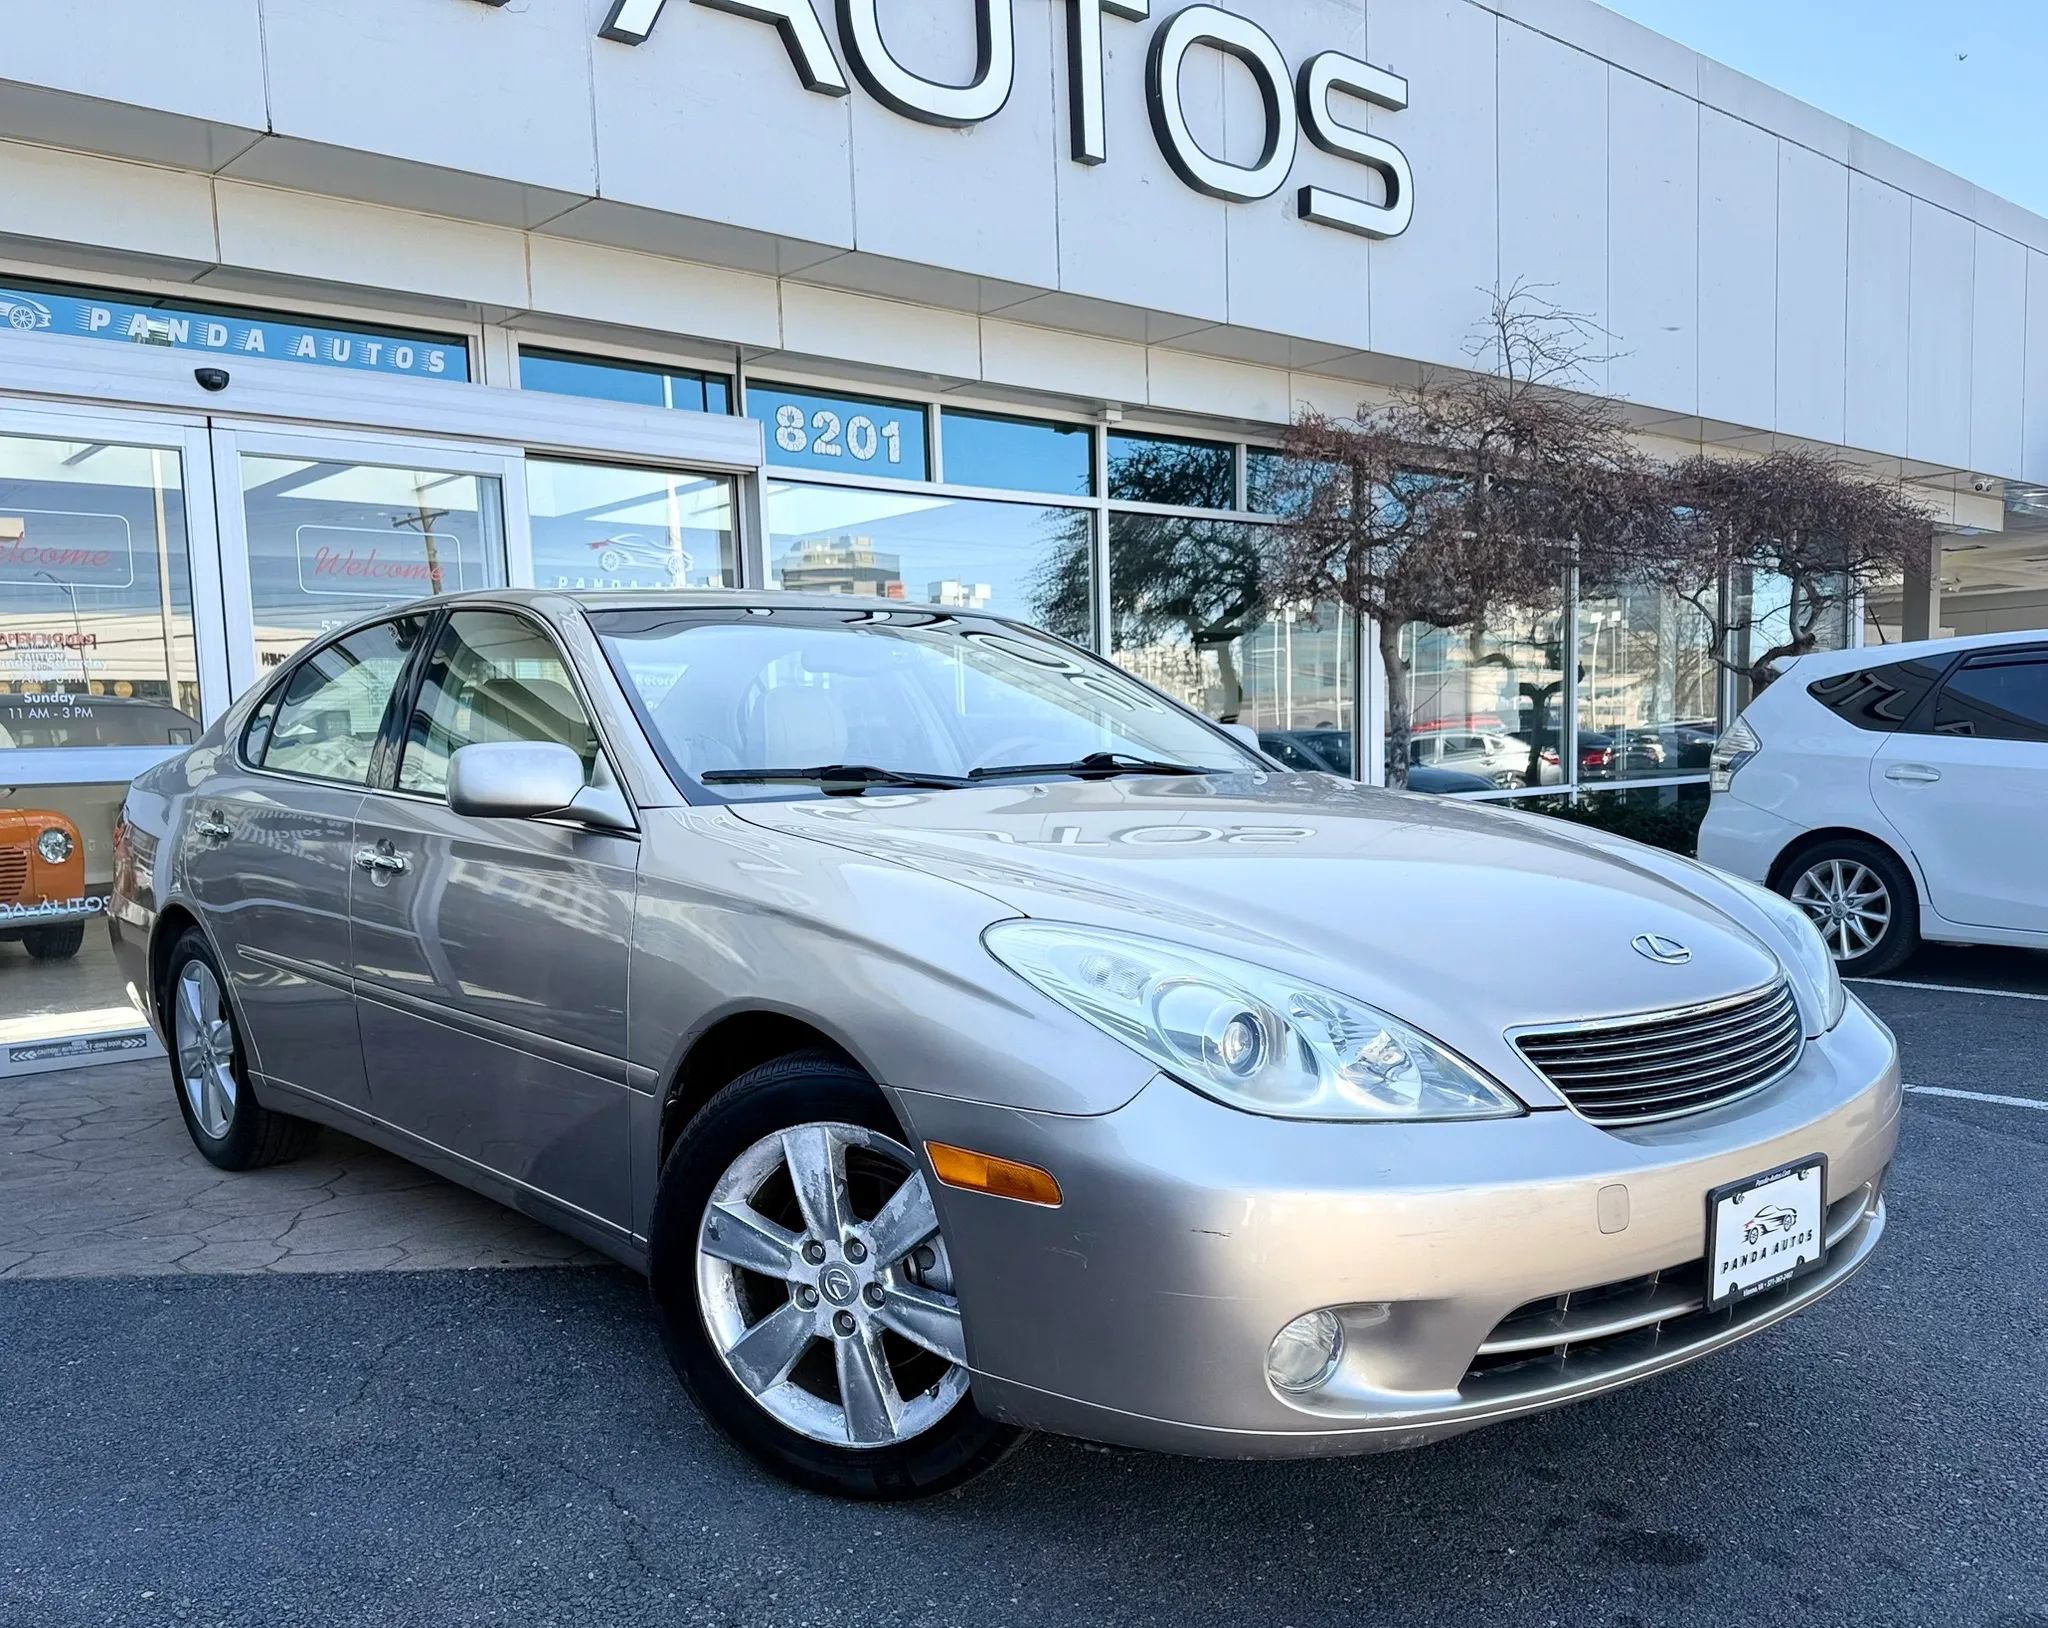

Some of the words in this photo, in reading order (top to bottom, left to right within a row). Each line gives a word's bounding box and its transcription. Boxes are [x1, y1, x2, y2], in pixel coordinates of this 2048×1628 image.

[86, 305, 265, 353] PANDA
[294, 334, 445, 373] AUTOS
[775, 405, 900, 463] 8201
[314, 546, 444, 580] Welcome
[9, 708, 22, 718] 11
[29, 708, 50, 718] AM
[62, 707, 70, 718] 3
[75, 707, 93, 718] PM
[24, 691, 76, 705] Sunday
[1720, 1247, 1767, 1275] PANDA
[1771, 1229, 1813, 1255] AUTOS
